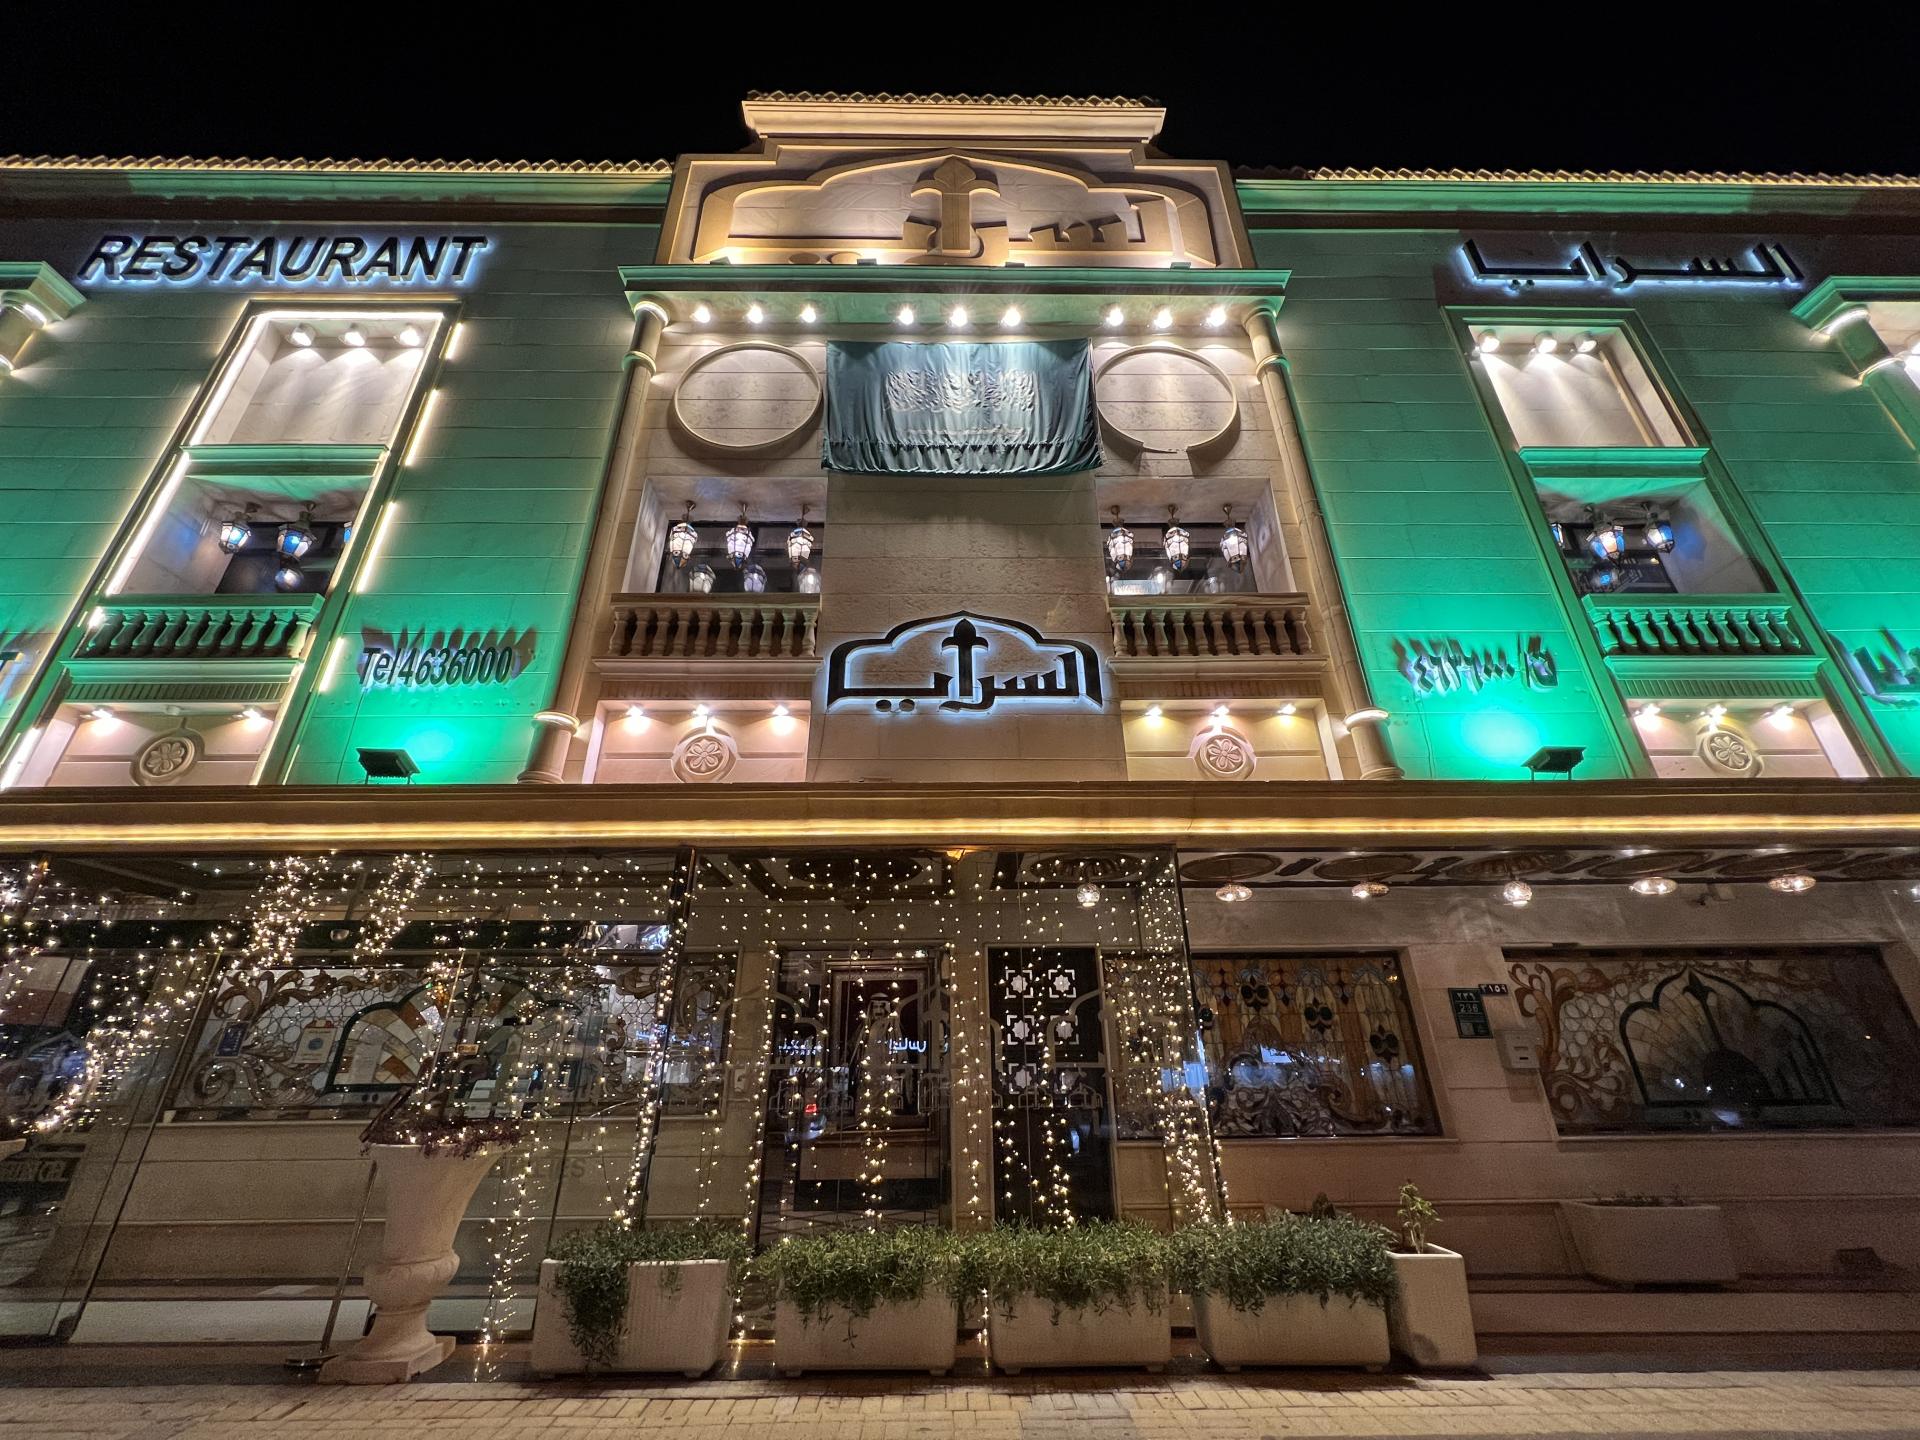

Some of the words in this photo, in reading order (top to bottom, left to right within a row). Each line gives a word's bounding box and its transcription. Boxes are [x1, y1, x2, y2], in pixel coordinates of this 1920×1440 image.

[79, 234, 489, 282] RESTAURANT
[1462, 238, 1805, 289] السرايا
[827, 610, 1104, 713] السرايا
